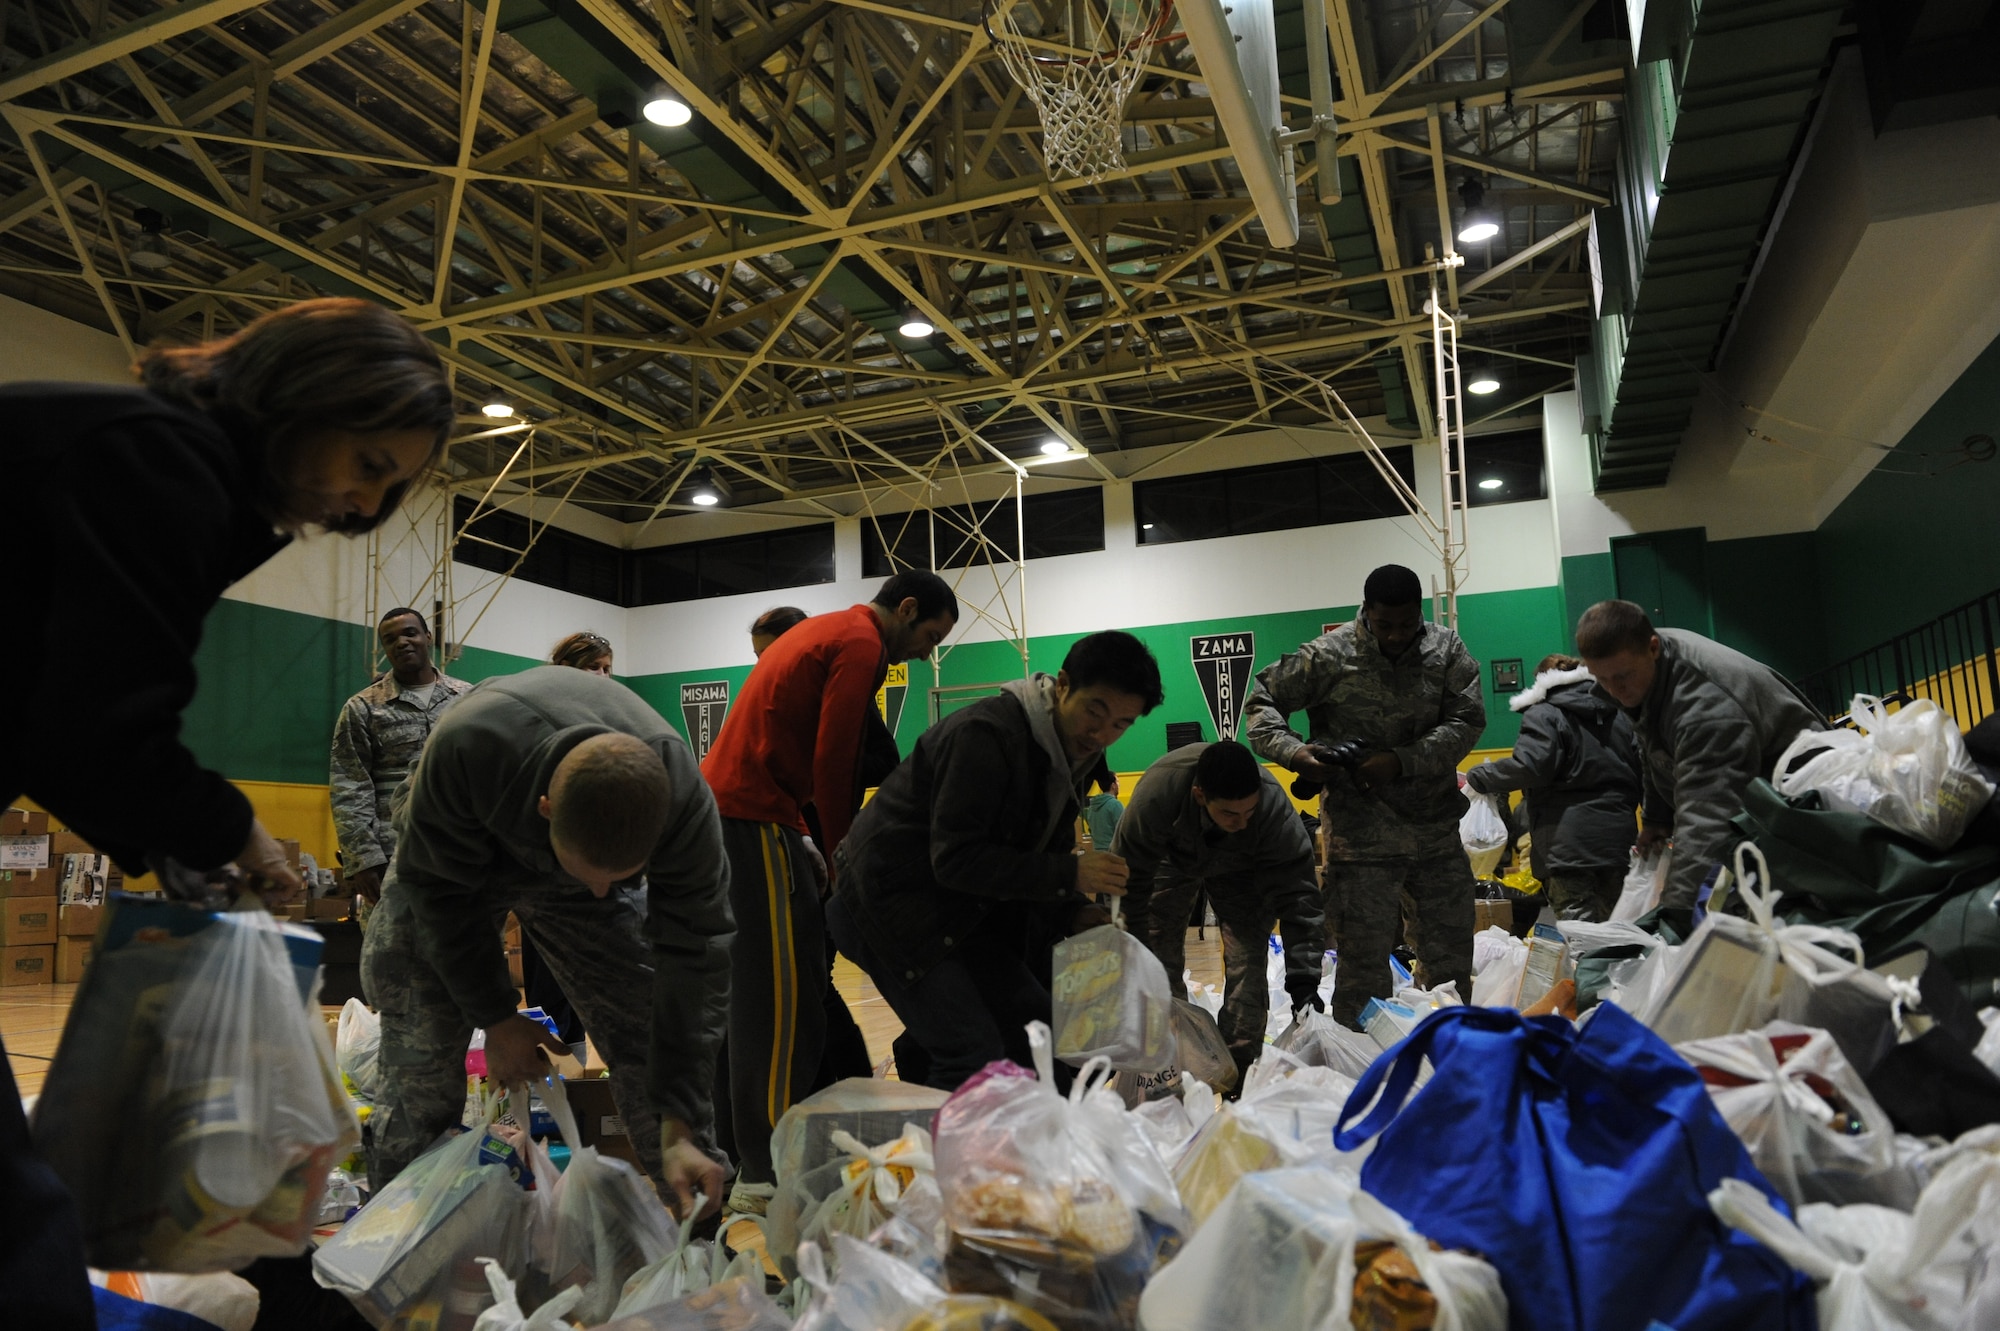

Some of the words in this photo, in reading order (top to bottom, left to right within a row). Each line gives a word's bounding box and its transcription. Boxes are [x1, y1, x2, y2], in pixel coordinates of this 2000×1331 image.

[1198, 637, 1246, 656] ZAMA
[885, 668, 905, 682] EN
[683, 686, 727, 702] MISAWA
[1219, 660, 1232, 739] TROJAN
